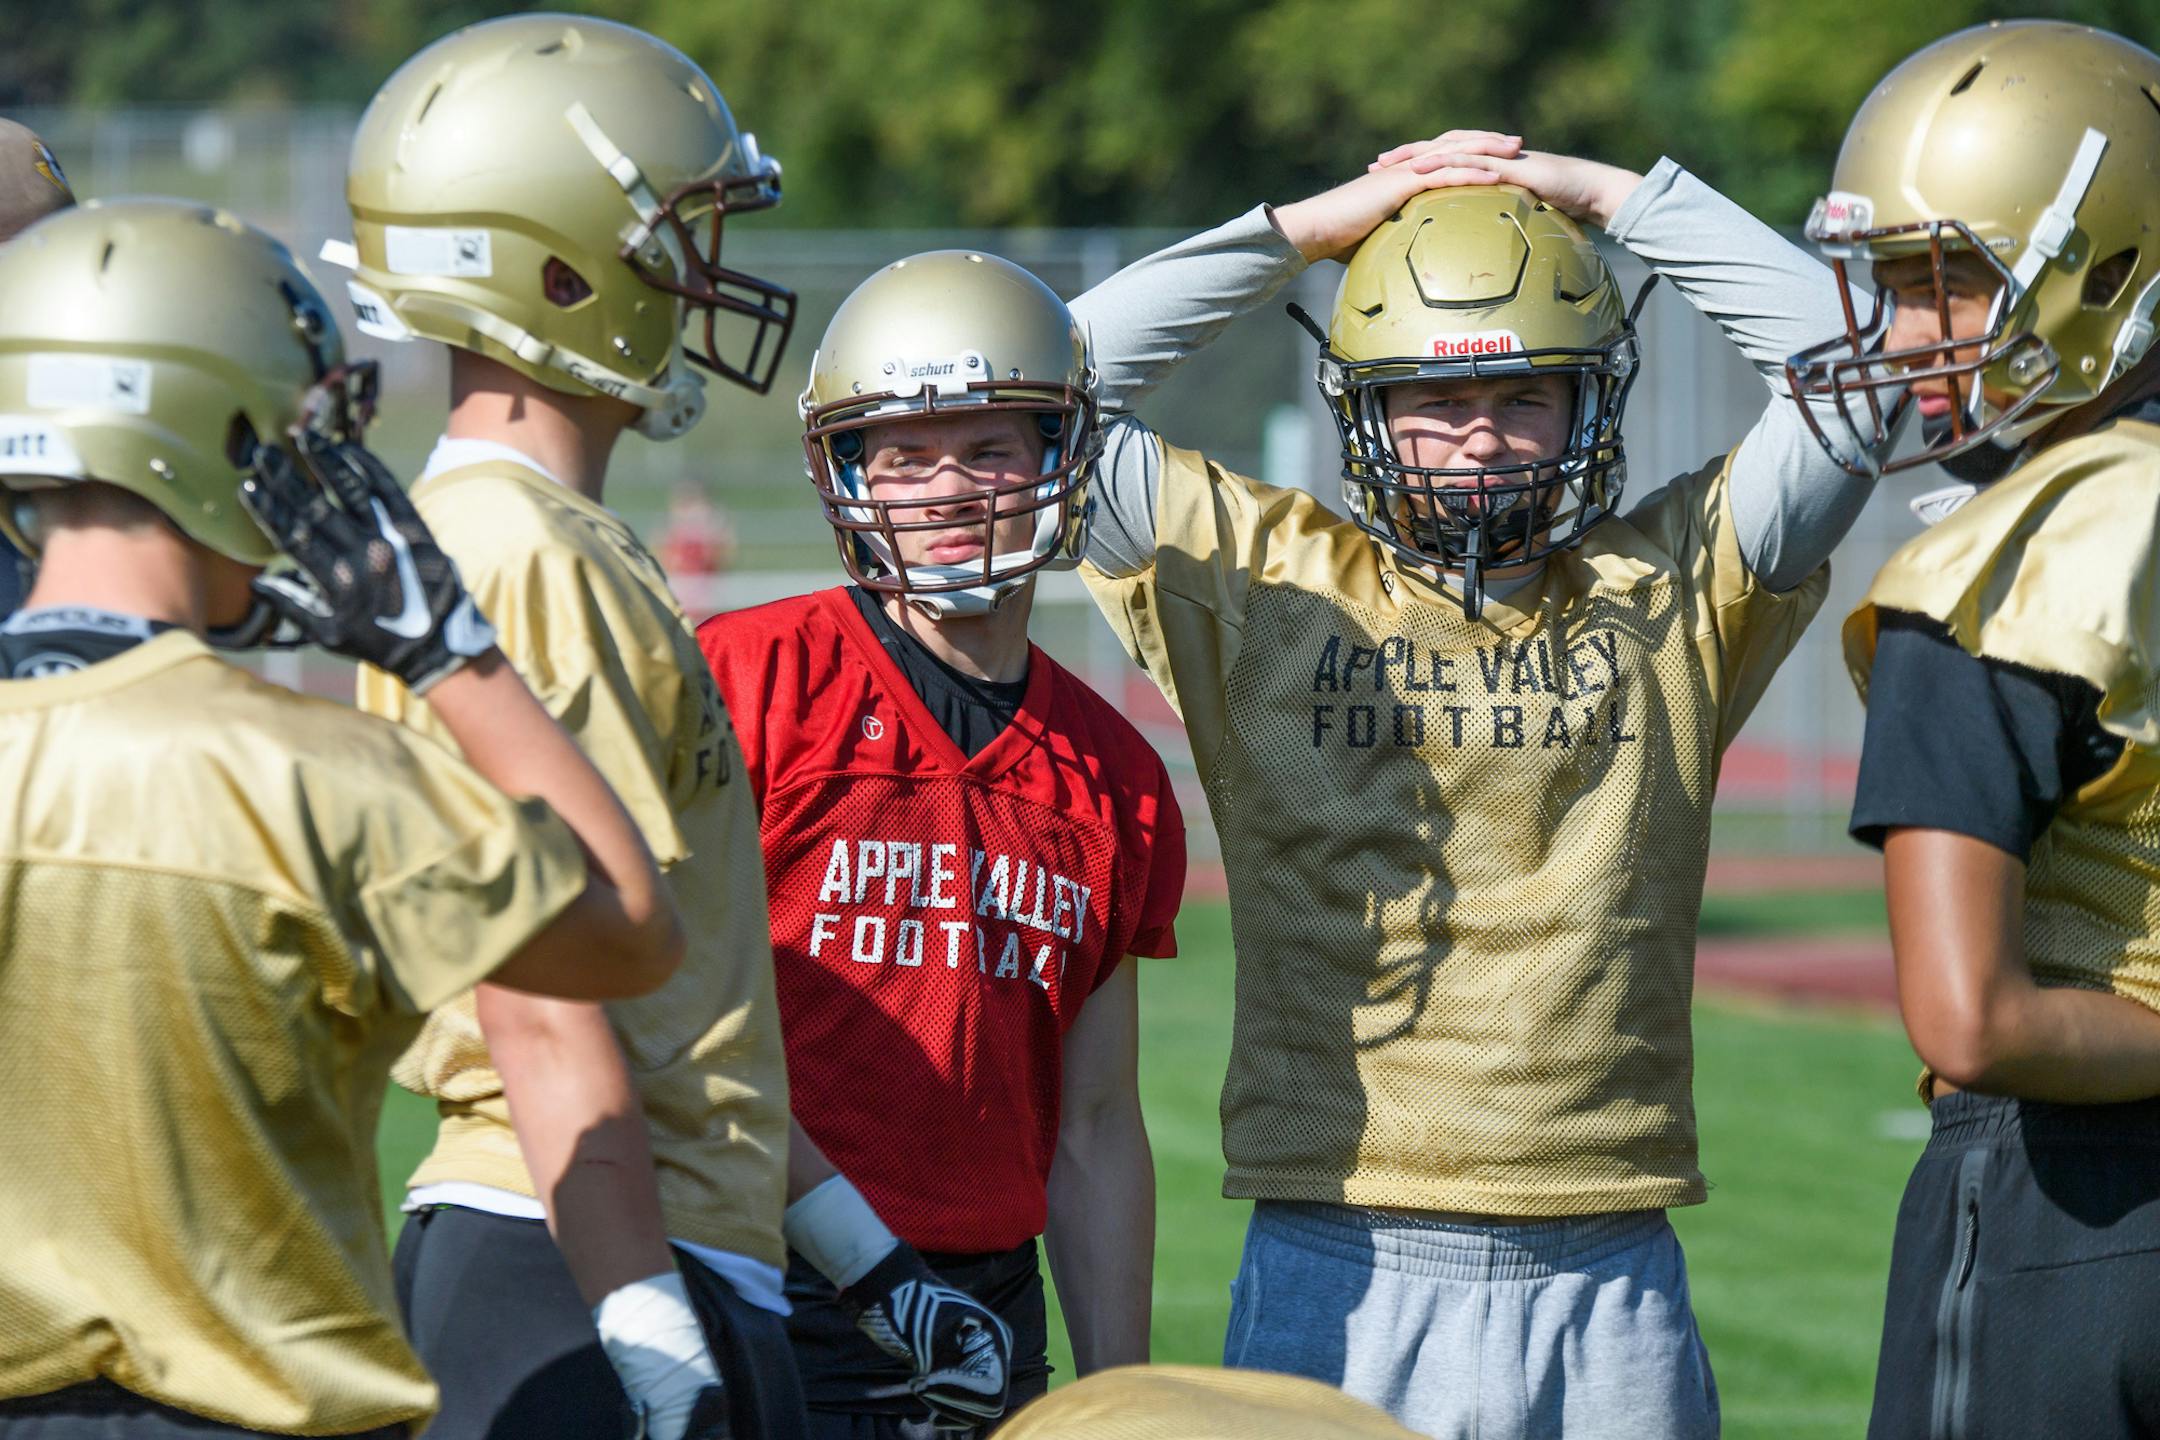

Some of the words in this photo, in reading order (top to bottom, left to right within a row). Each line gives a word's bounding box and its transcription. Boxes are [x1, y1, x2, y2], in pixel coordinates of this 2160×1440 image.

[910, 363, 955, 377] schutt
[1433, 335, 1512, 357] Riddell
[1313, 635, 1457, 692] APPLE
[818, 839, 957, 909] APPLE
[809, 913, 1067, 991] FOOTAL
